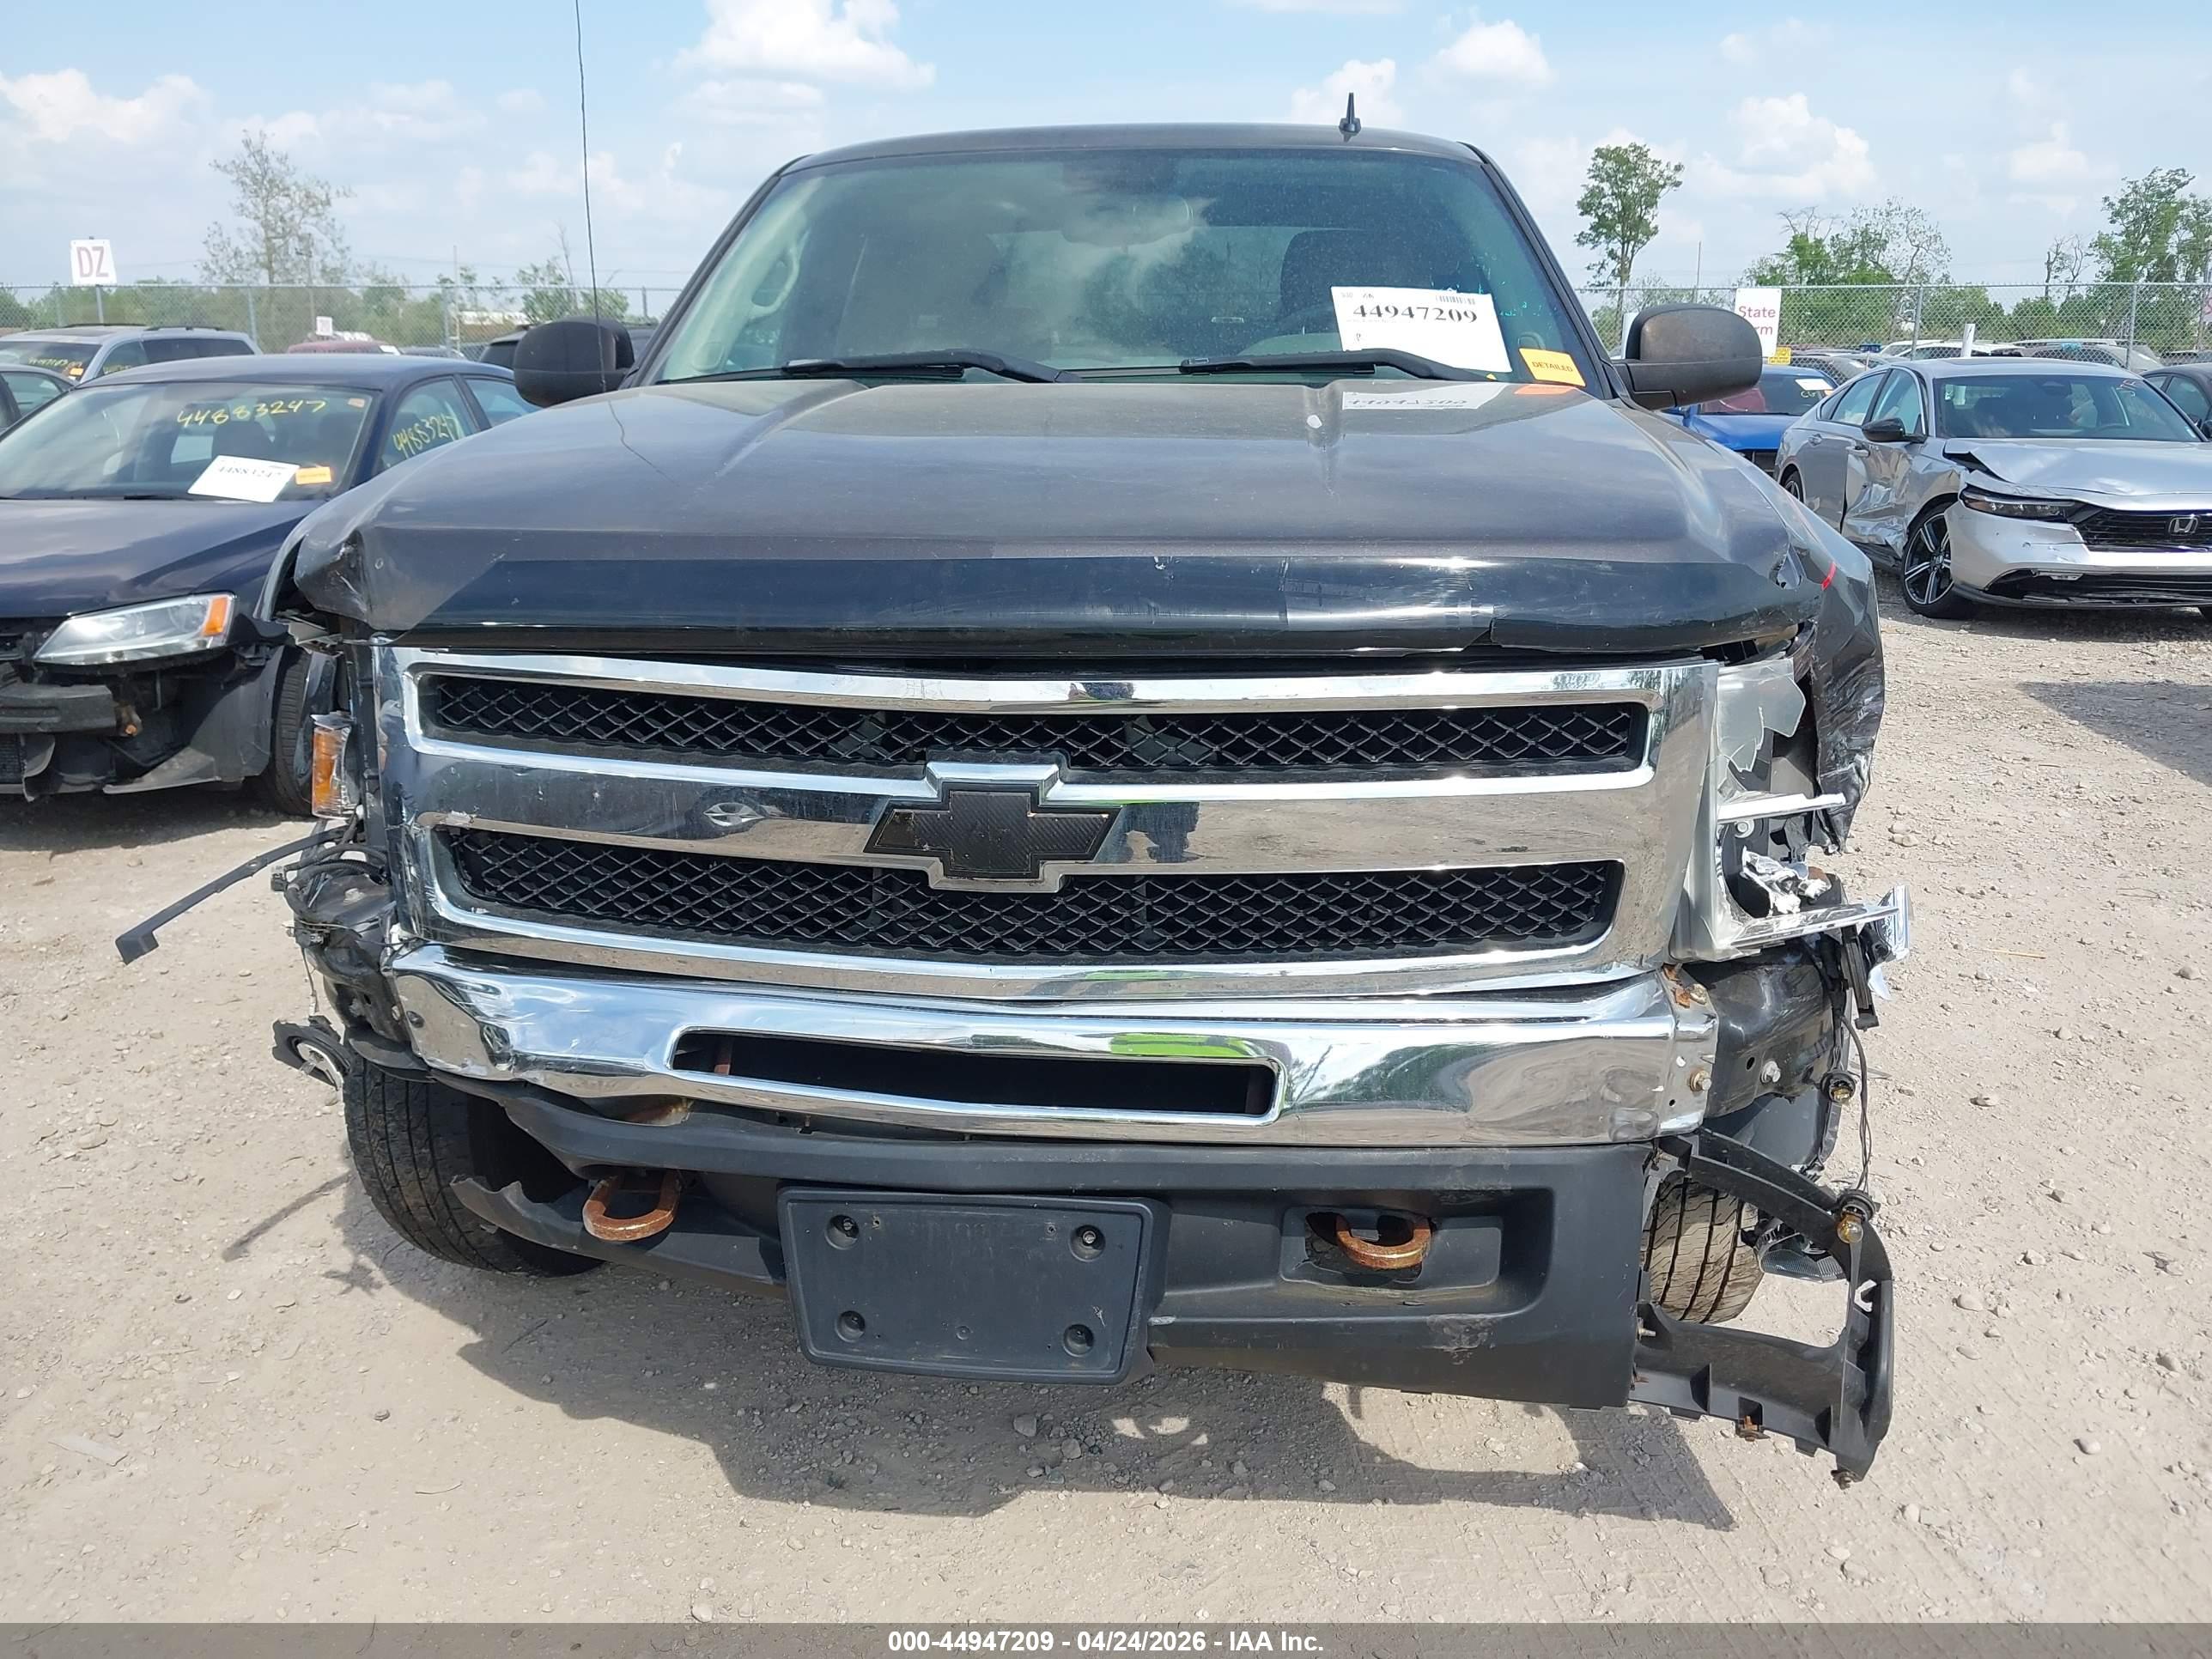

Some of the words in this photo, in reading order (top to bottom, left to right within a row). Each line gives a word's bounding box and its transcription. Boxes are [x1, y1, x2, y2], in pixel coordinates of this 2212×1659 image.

[76, 246, 109, 277] DZ
[1353, 305, 1478, 323] 44947209
[1739, 306, 1776, 318] State
[1531, 362, 1573, 372] DETAILED
[177, 399, 326, 428] 44883247
